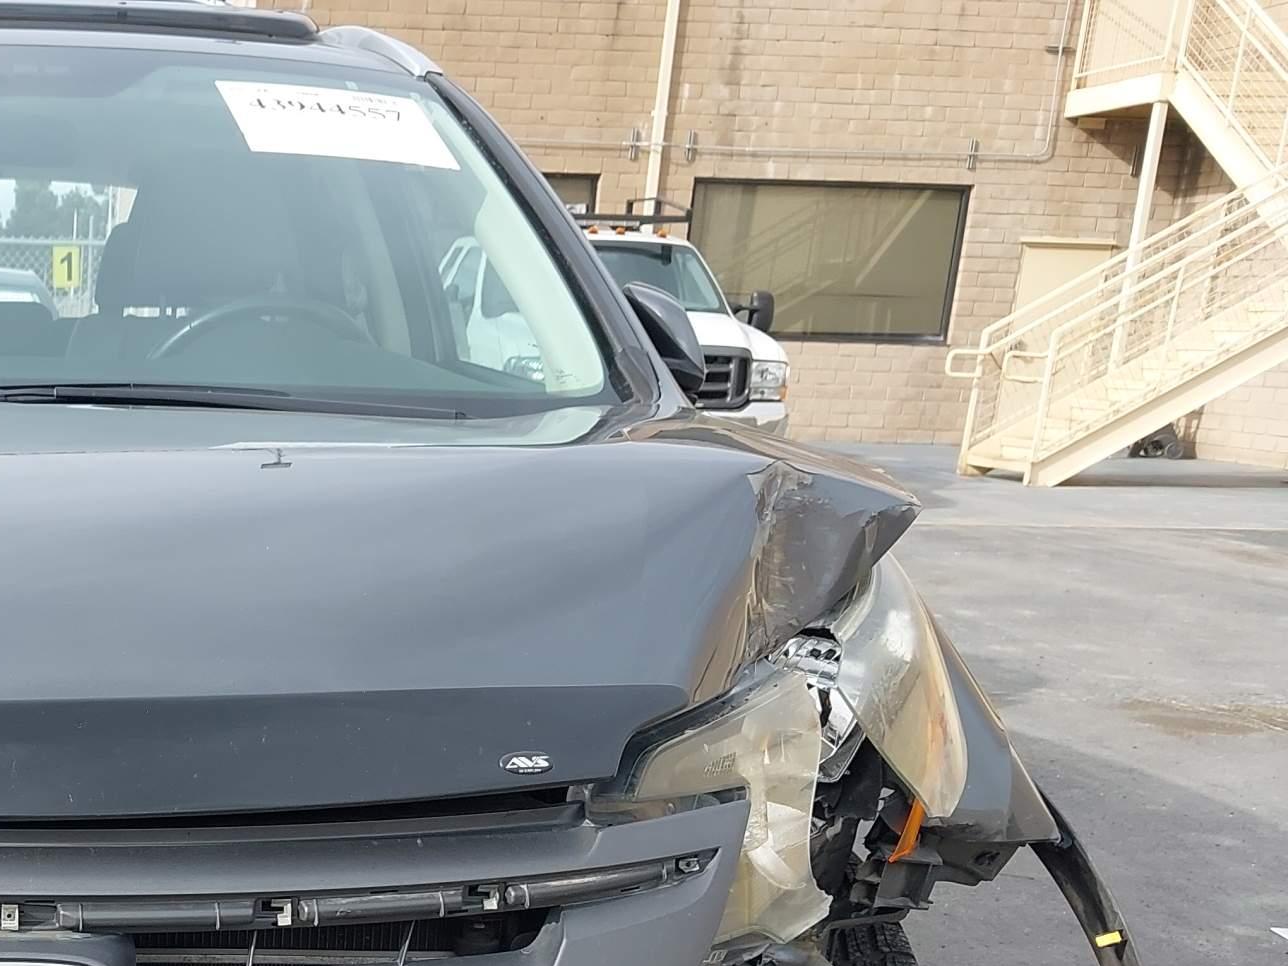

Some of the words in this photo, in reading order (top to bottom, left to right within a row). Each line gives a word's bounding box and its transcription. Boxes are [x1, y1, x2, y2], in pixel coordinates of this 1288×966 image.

[249, 98, 400, 121] 43944557
[60, 251, 73, 281] 1
[505, 755, 550, 769] AVS
